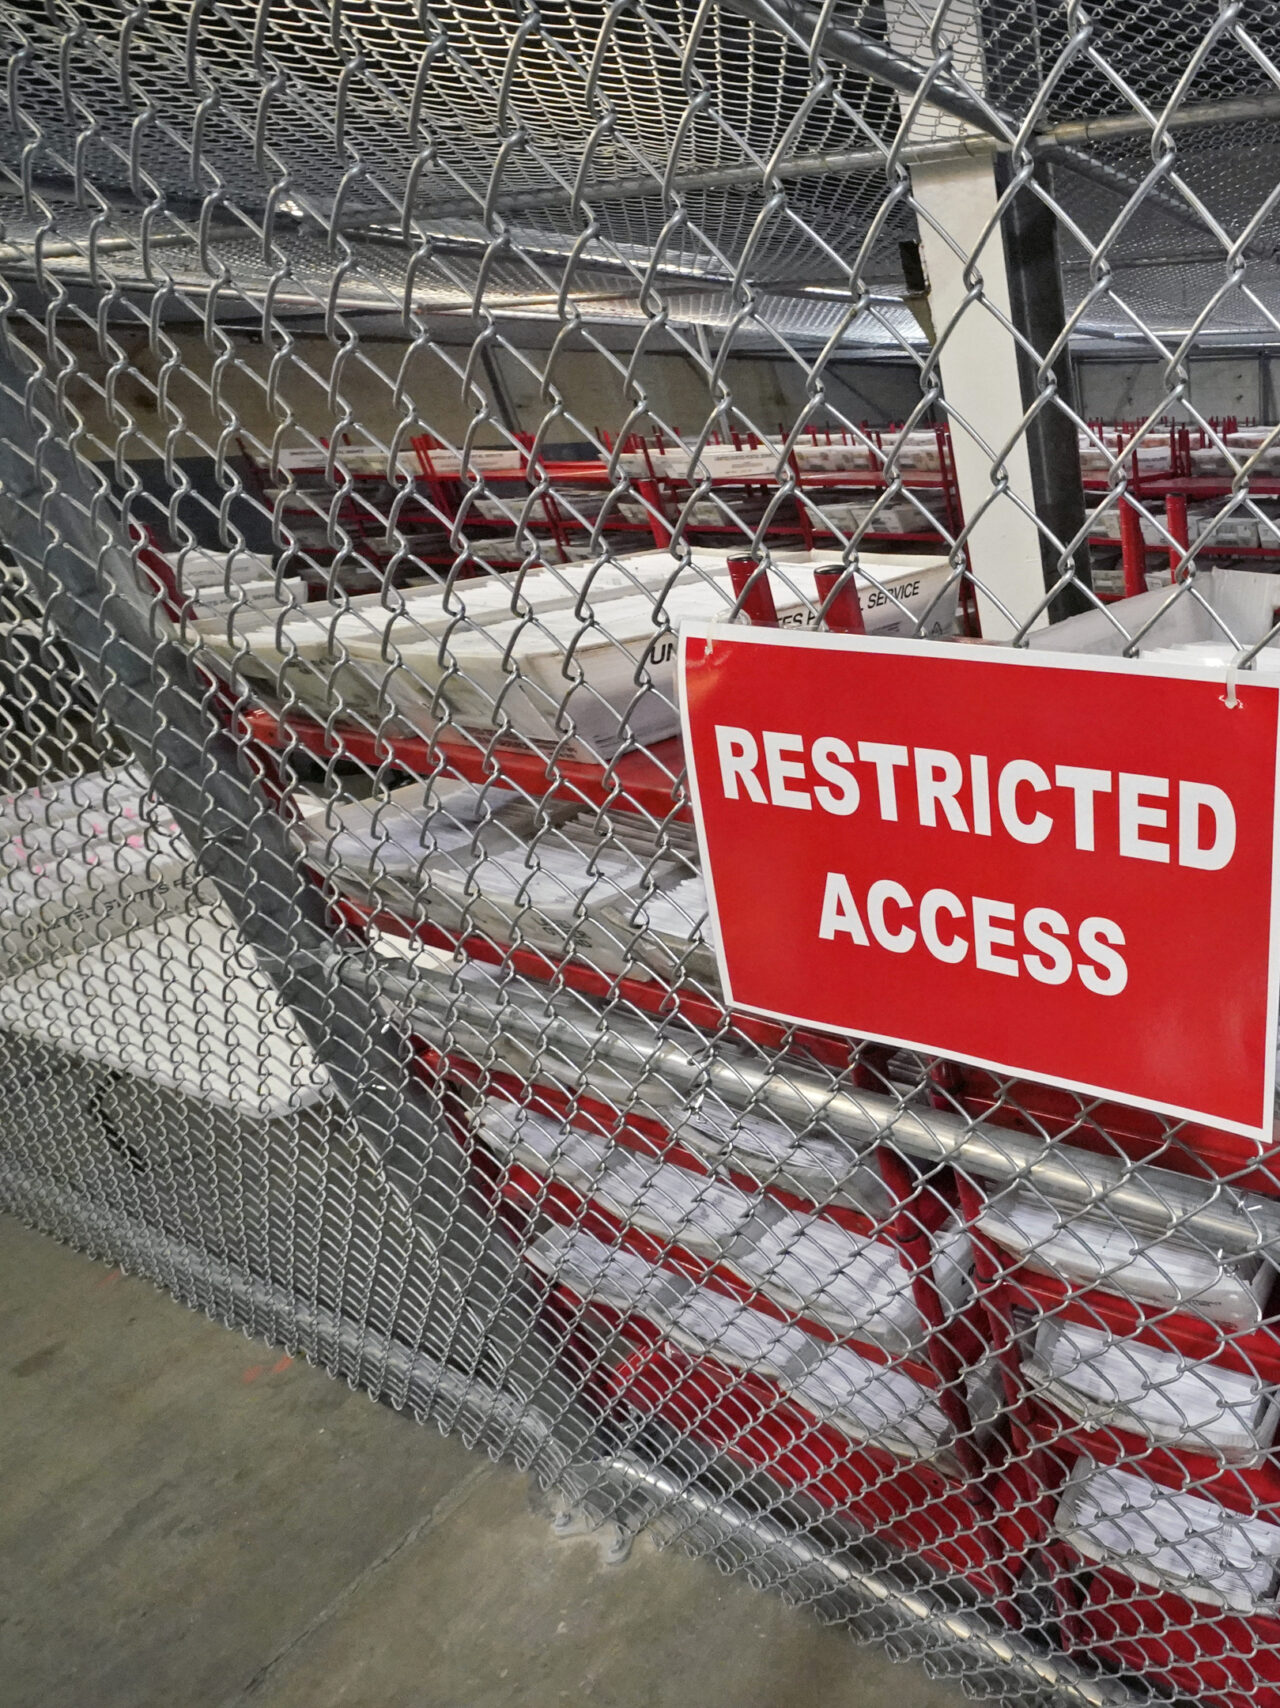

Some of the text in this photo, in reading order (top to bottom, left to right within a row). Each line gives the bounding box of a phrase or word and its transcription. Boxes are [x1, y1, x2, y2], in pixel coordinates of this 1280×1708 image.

[867, 580, 921, 609] SERVICE
[714, 725, 1237, 871] RESTRICTED
[818, 872, 1128, 996] ACCESS
